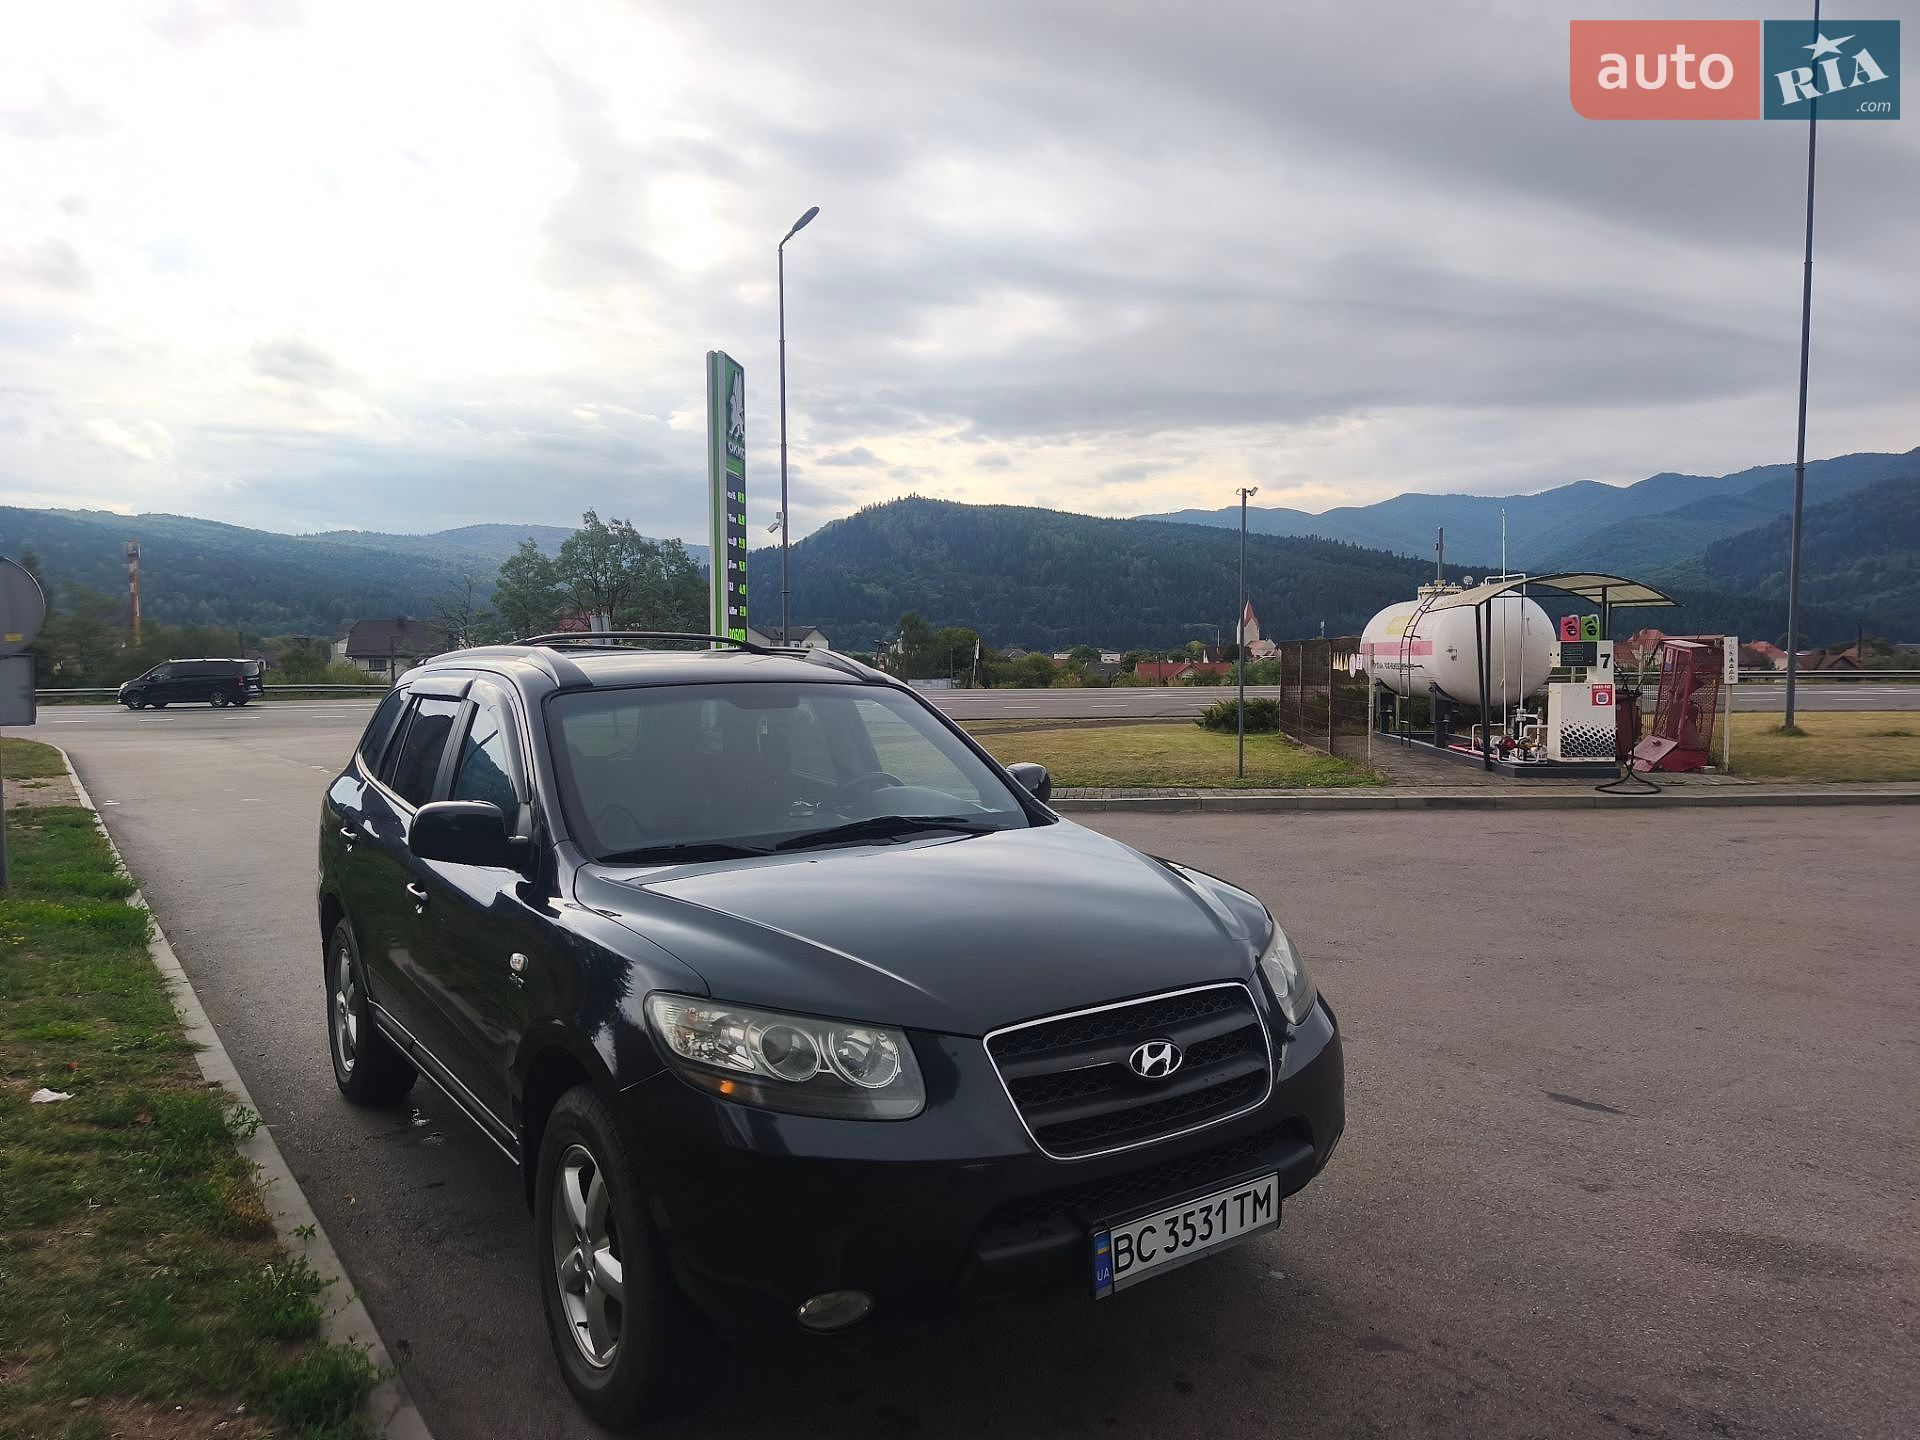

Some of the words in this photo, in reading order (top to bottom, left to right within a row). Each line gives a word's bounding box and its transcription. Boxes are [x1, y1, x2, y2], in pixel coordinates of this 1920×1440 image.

[1600, 653, 1611, 669] 7
[1113, 1225, 1157, 1275] BC
[1163, 1199, 1227, 1253] 3531
[1233, 1183, 1272, 1227] TM
[1096, 1266, 1110, 1281] UA
